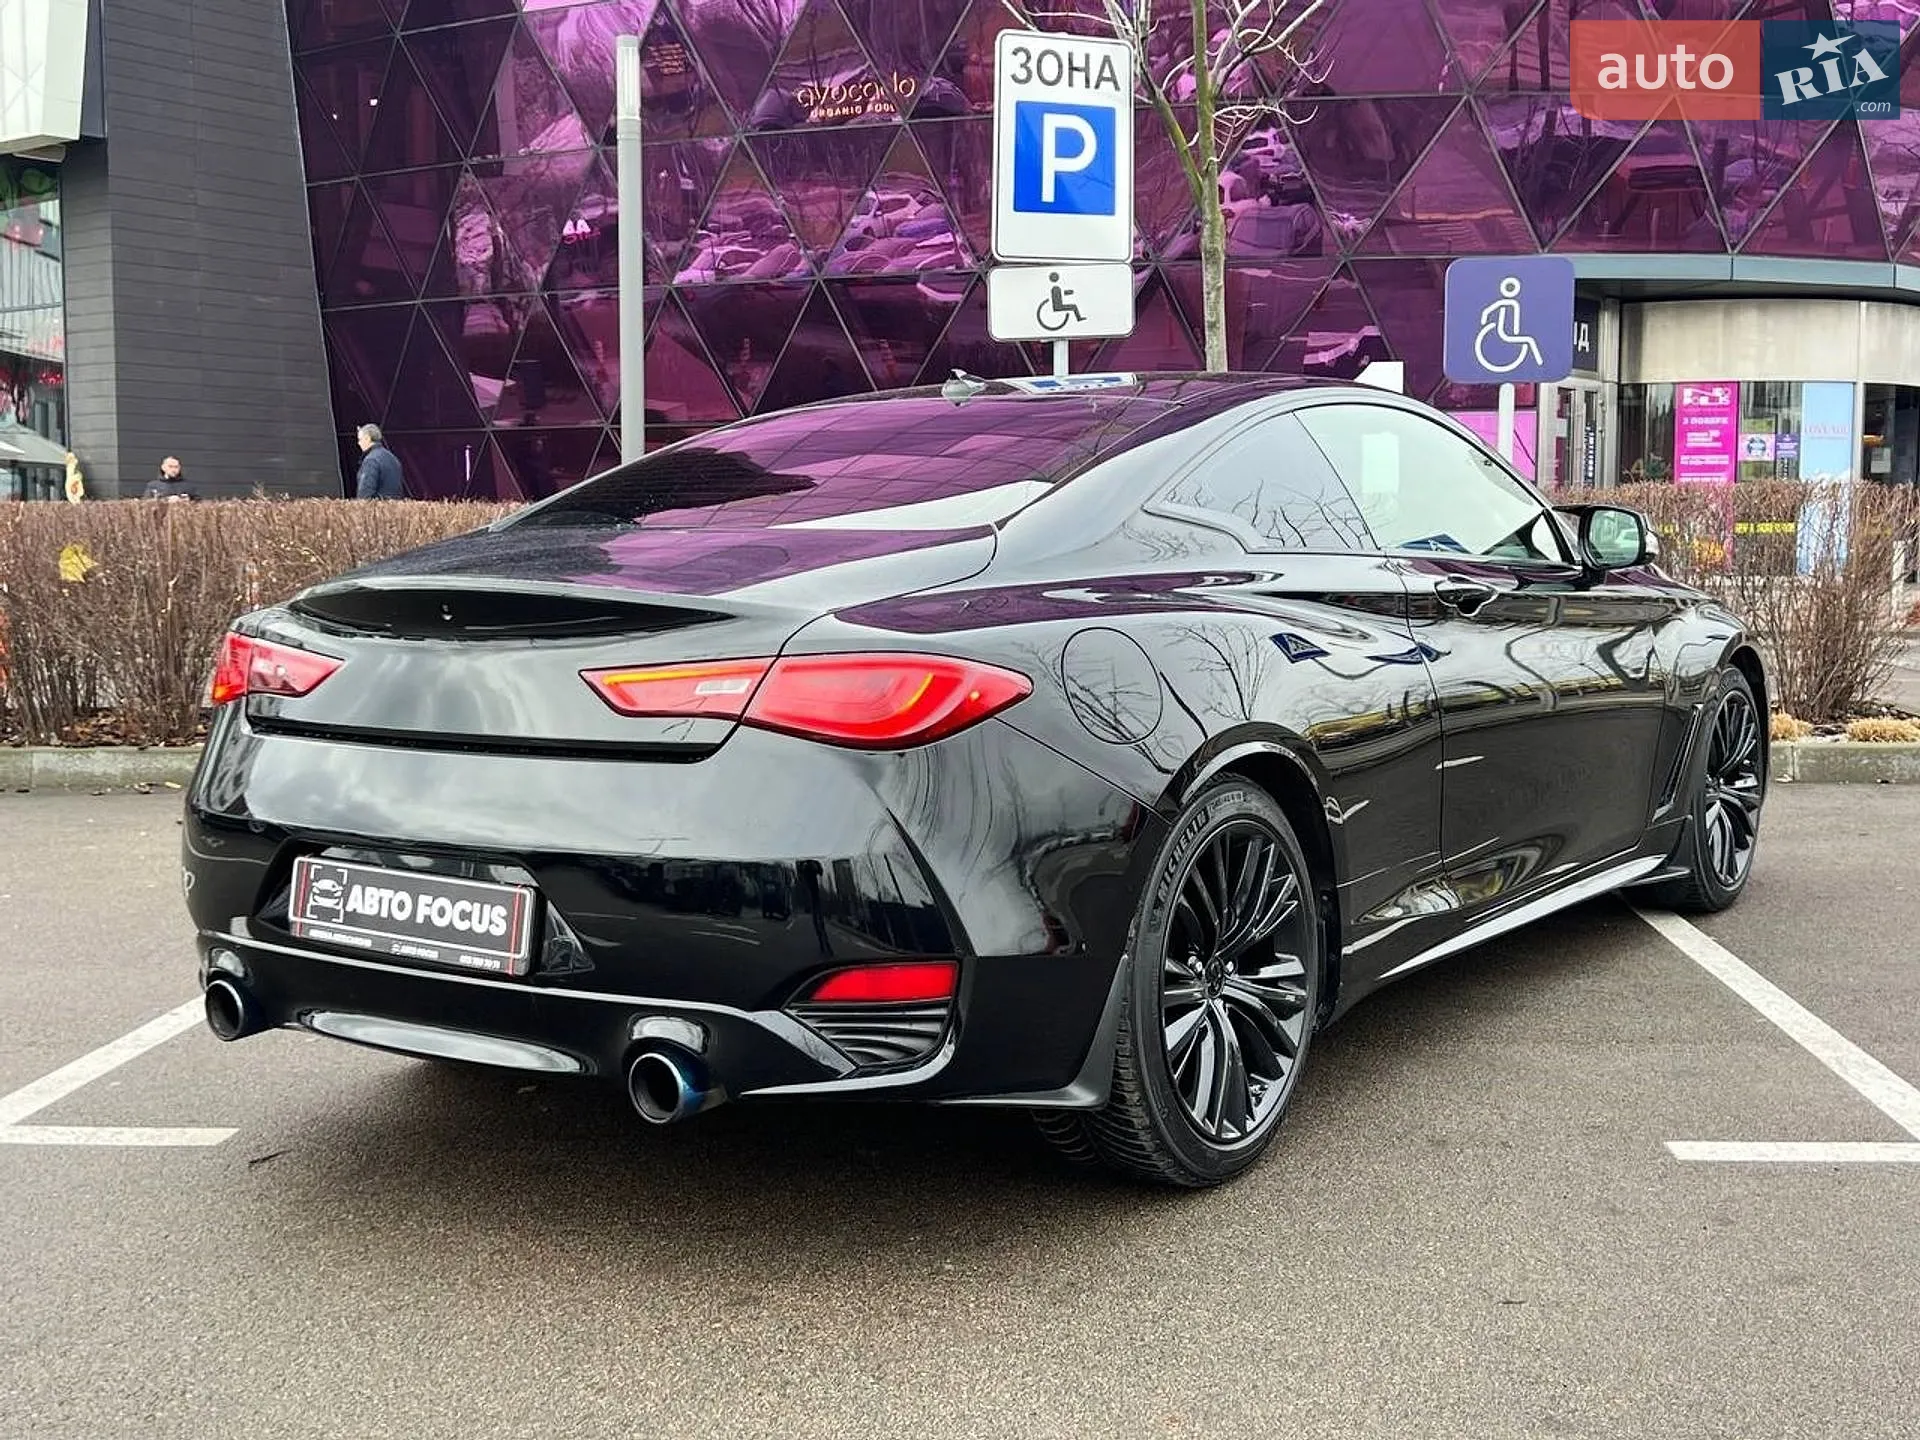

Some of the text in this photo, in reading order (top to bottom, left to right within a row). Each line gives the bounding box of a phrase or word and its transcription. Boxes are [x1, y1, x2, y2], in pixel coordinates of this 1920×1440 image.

[1010, 46, 1121, 92] ЗОНА
[1041, 112, 1098, 204] P
[1157, 807, 1210, 903] MICHELIN
[415, 894, 508, 937] FOCUS
